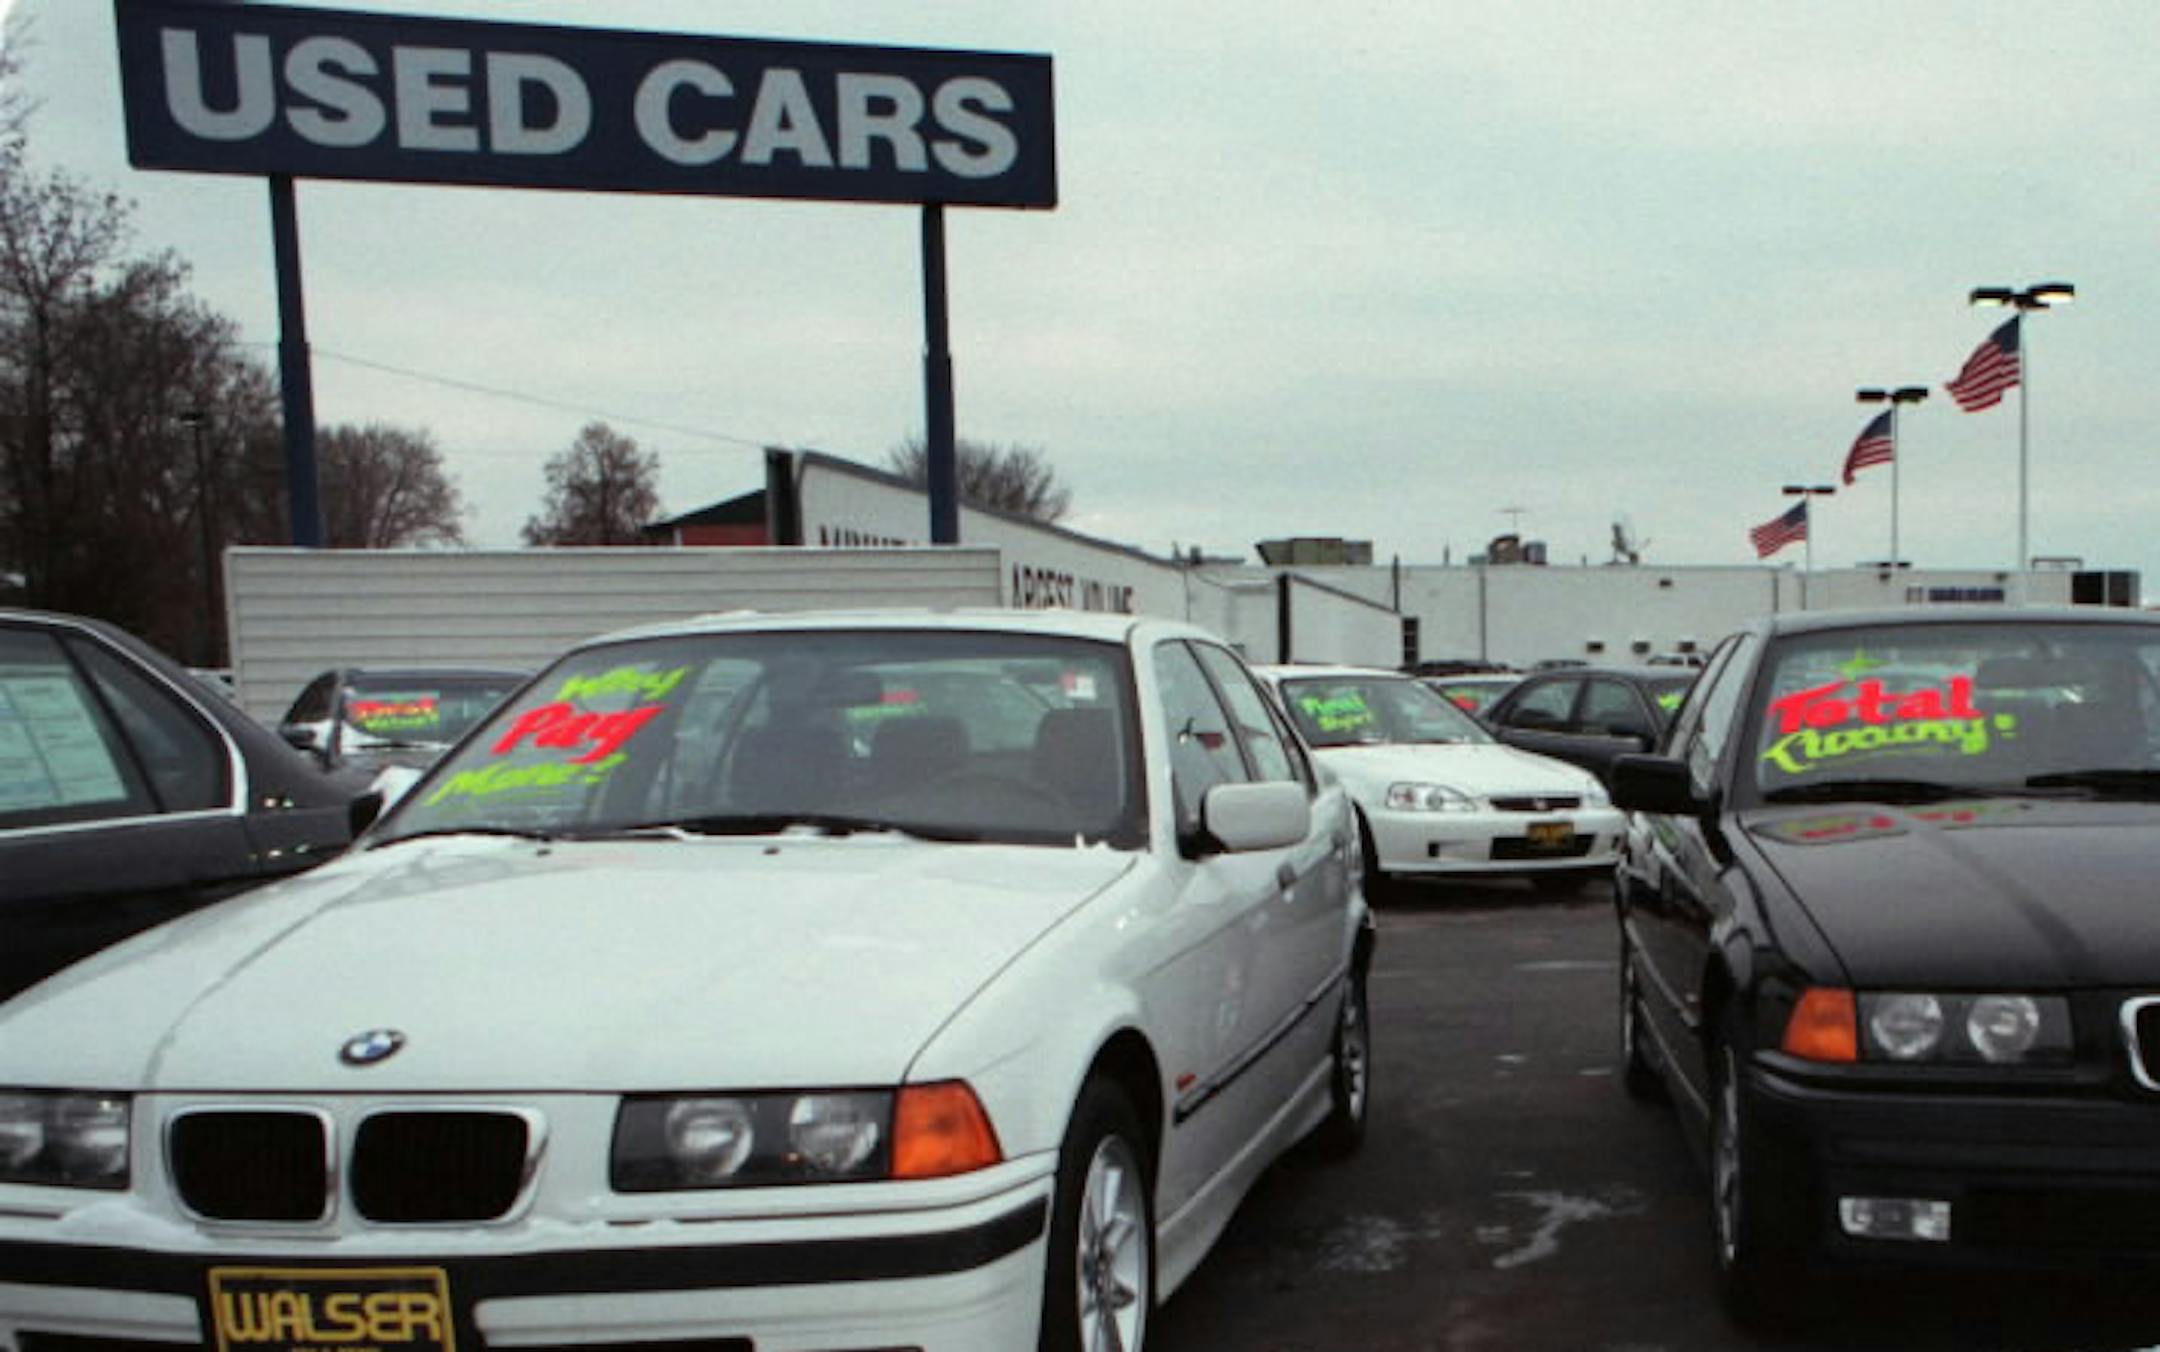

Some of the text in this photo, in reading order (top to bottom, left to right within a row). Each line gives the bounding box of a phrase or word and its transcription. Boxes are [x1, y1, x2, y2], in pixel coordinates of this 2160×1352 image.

[160, 27, 1019, 179] USED CARS
[490, 701, 667, 764] Pay
[1768, 673, 1984, 734] Total
[219, 1290, 442, 1342] WALSER
